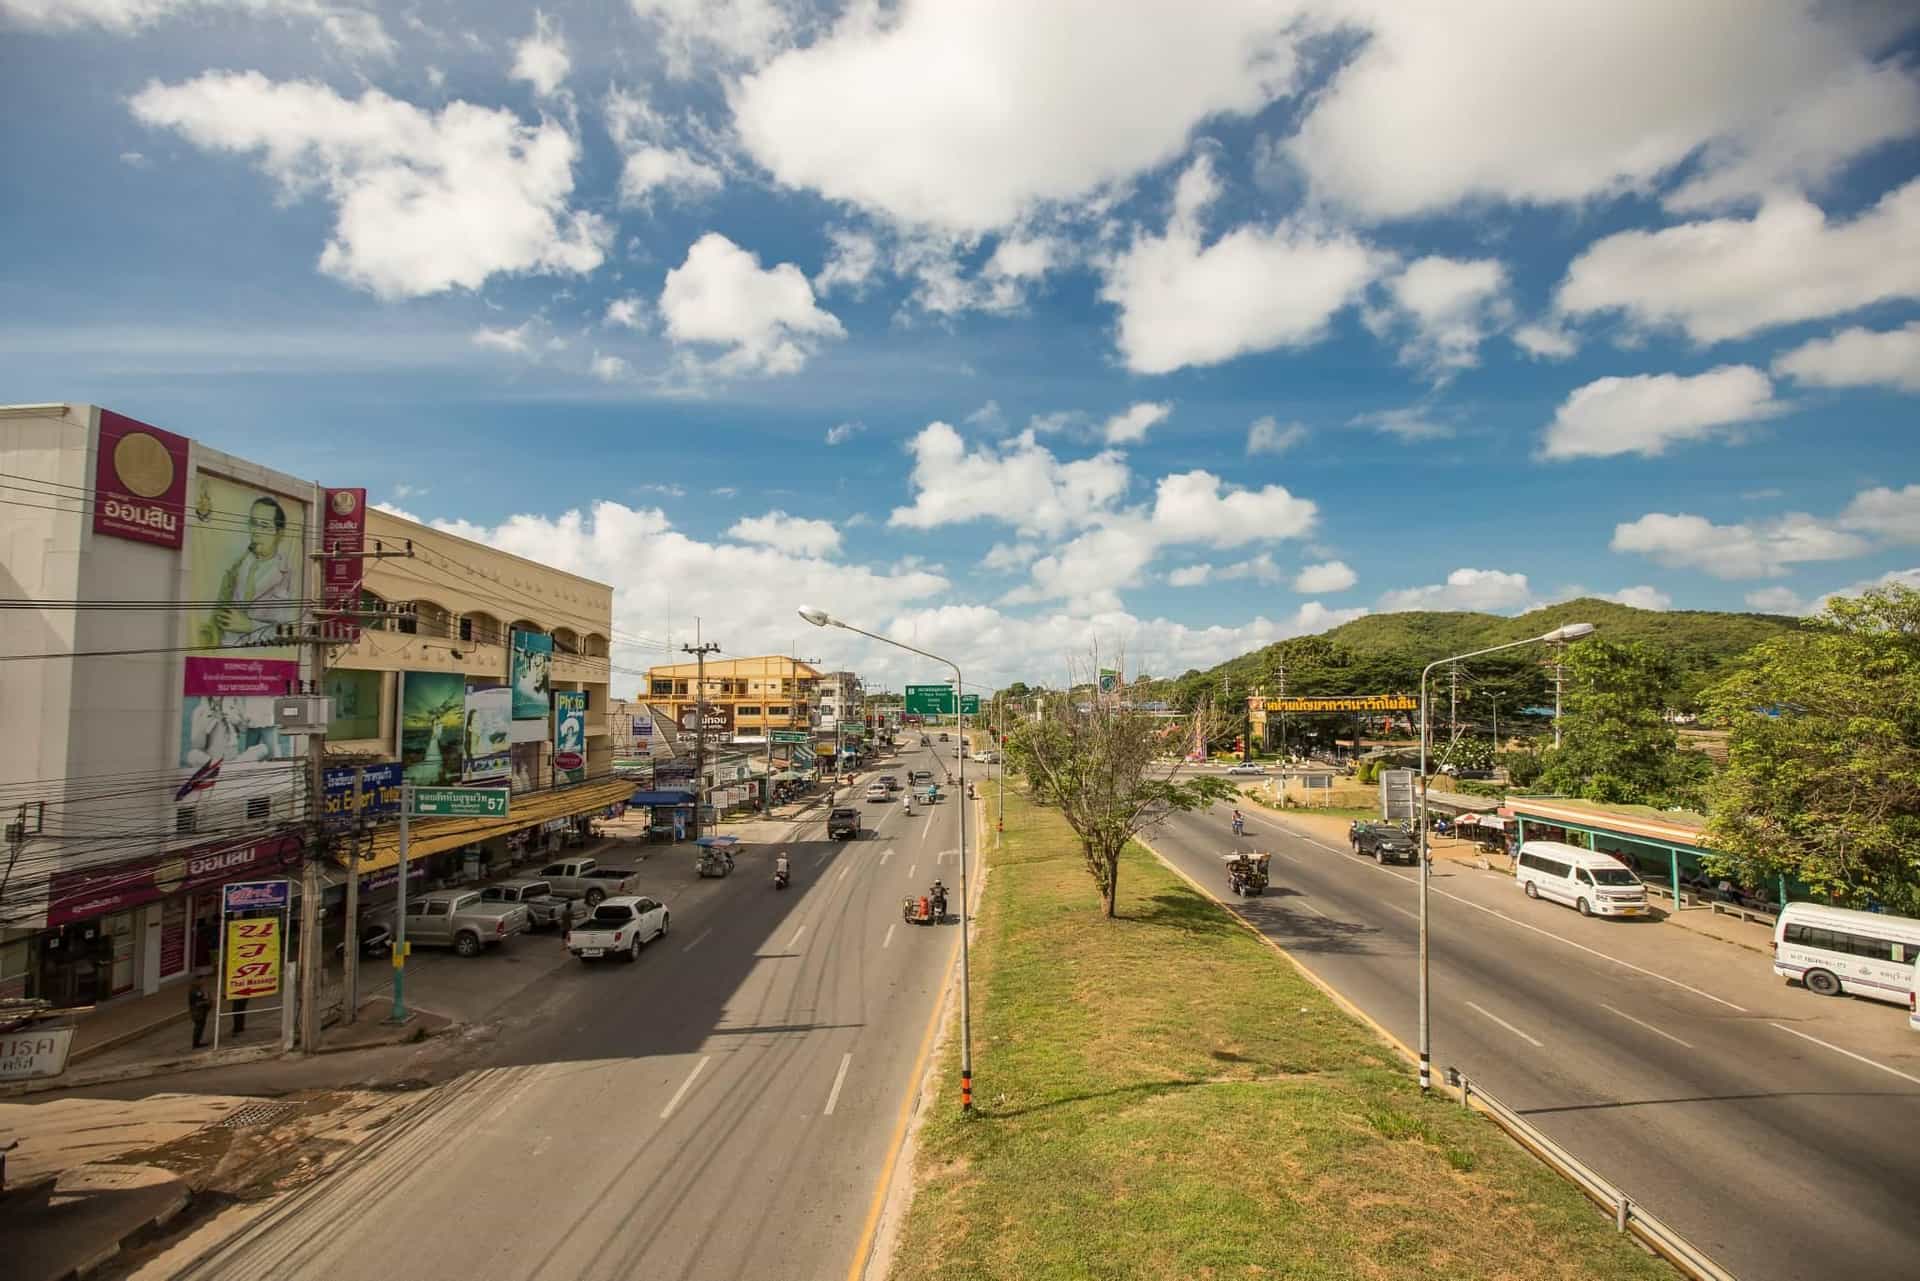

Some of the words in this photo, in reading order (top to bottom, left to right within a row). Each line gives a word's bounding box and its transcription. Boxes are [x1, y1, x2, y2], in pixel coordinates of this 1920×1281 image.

[104, 501, 176, 532] ออมสิน
[559, 695, 584, 710] Phto
[487, 797, 505, 811] 57
